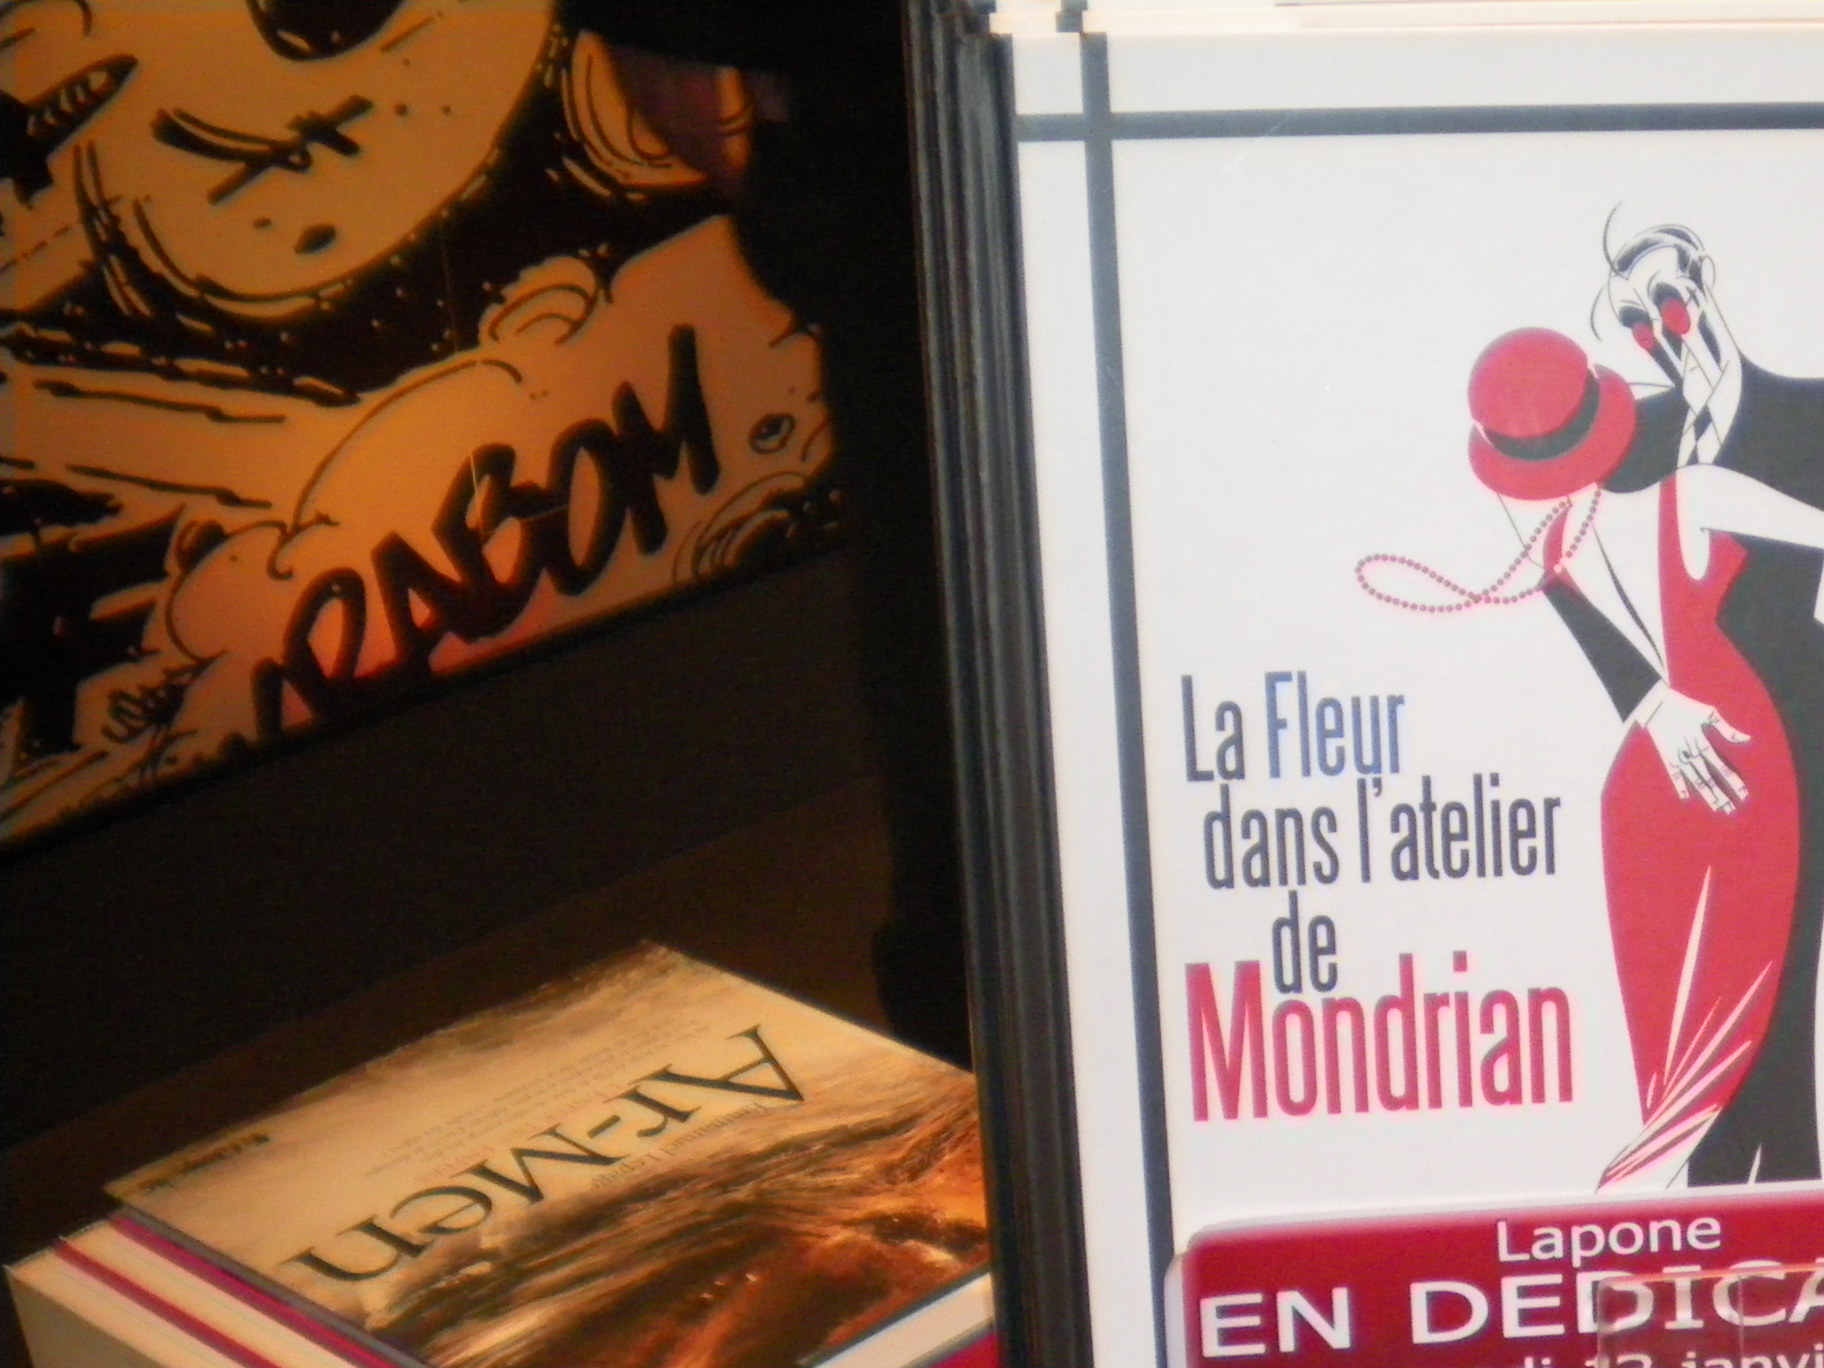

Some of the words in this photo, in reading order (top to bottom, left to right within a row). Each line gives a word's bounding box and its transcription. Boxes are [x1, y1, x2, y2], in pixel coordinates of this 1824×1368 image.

[1181, 674, 1246, 783] La
[1264, 670, 1406, 780] Fleur
[1203, 783, 1340, 889] dans
[1357, 772, 1562, 884] l’atelier
[1271, 889, 1339, 994] de
[1184, 950, 1574, 1123] Mondrian
[279, 1024, 806, 1284] Ar-Men
[1495, 1214, 1724, 1272] Lapone
[1201, 1285, 1354, 1359] EN
